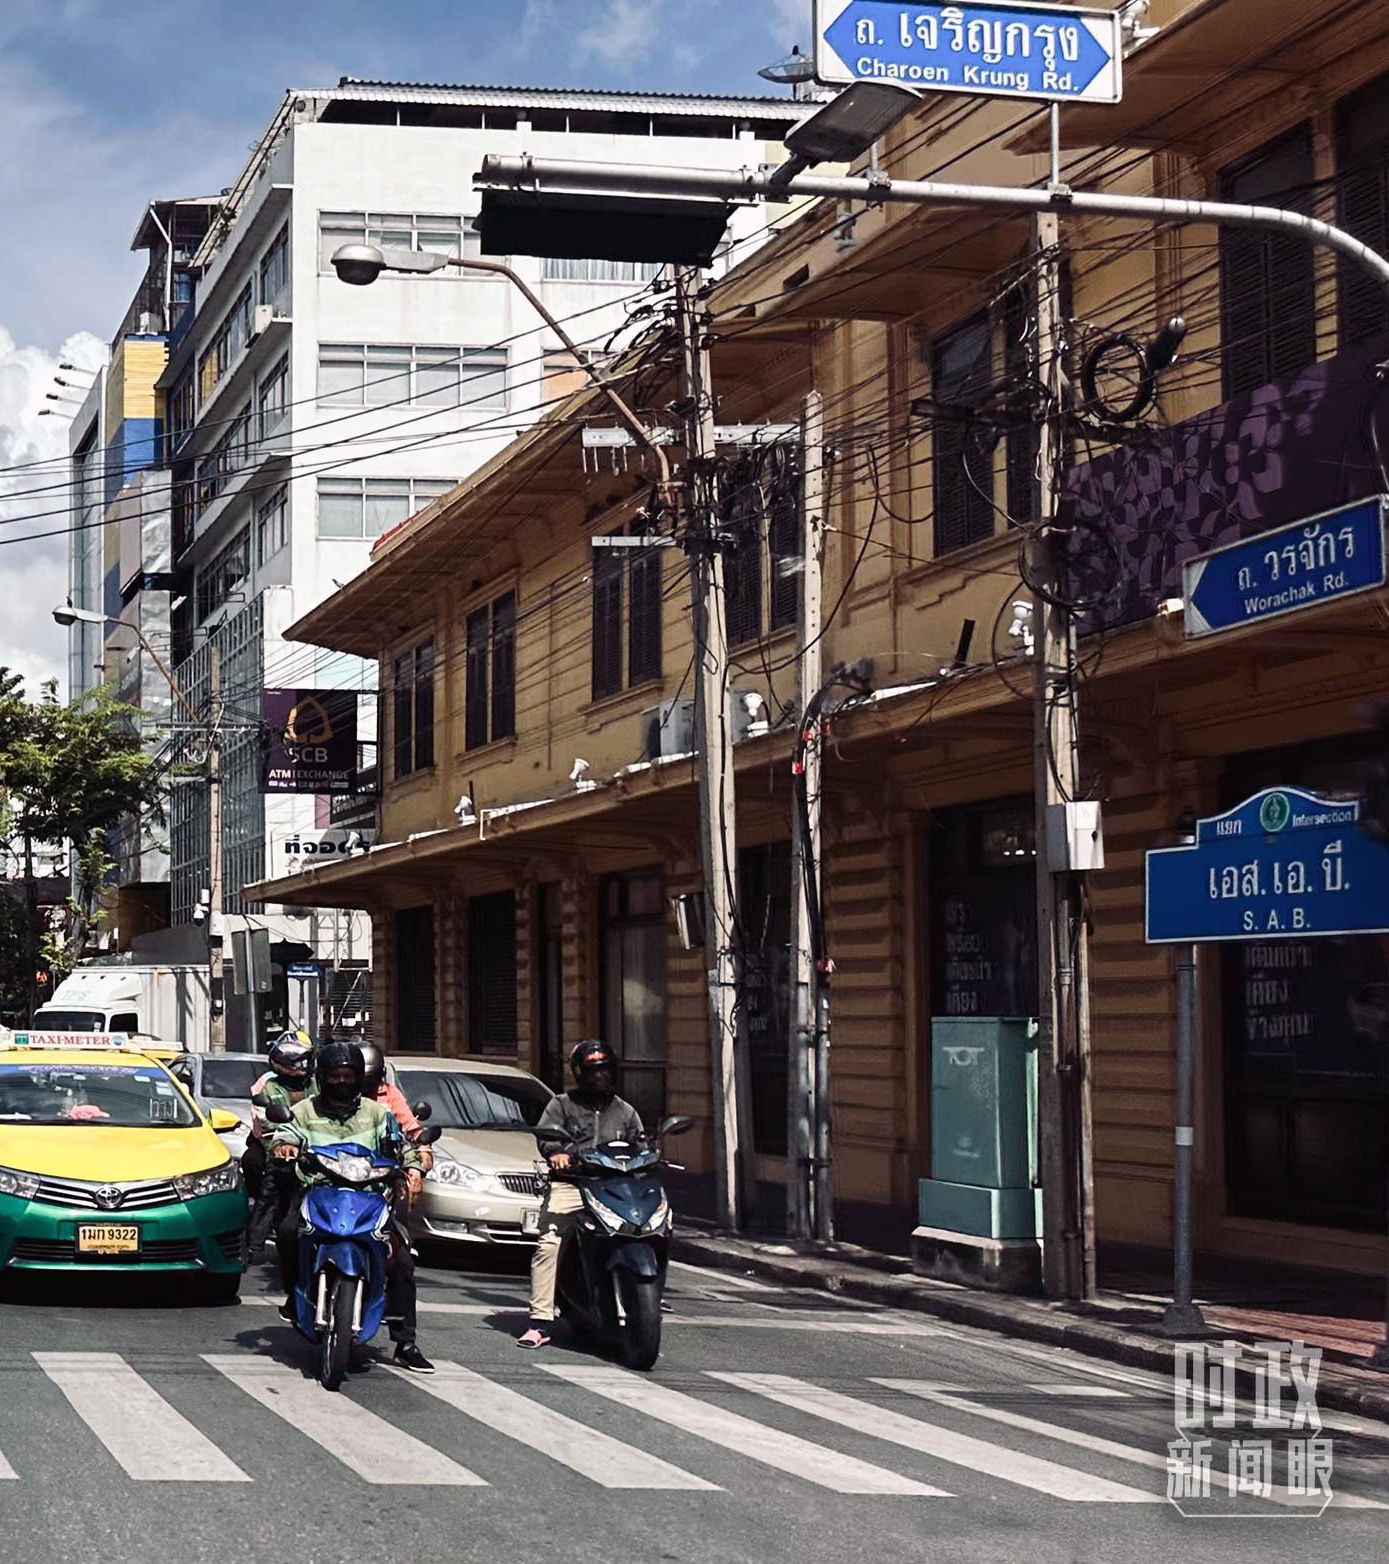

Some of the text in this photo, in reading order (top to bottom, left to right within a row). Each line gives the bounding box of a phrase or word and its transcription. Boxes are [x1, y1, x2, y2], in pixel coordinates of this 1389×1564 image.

[856, 7, 1079, 71] ถ. เจริญกรุง
[857, 57, 1080, 92] Charoen Krung Rd.
[1238, 524, 1354, 591] ถ. วรจักร
[1244, 572, 1349, 614] Worachak Rd.
[289, 747, 328, 763] SCB
[268, 769, 349, 779] ATM EXCHANGE
[1216, 819, 1243, 836] แยก
[1292, 811, 1352, 828] Intersection
[31, 1033, 110, 1046] TAXI-METER
[108, 1229, 137, 1241] 9322
